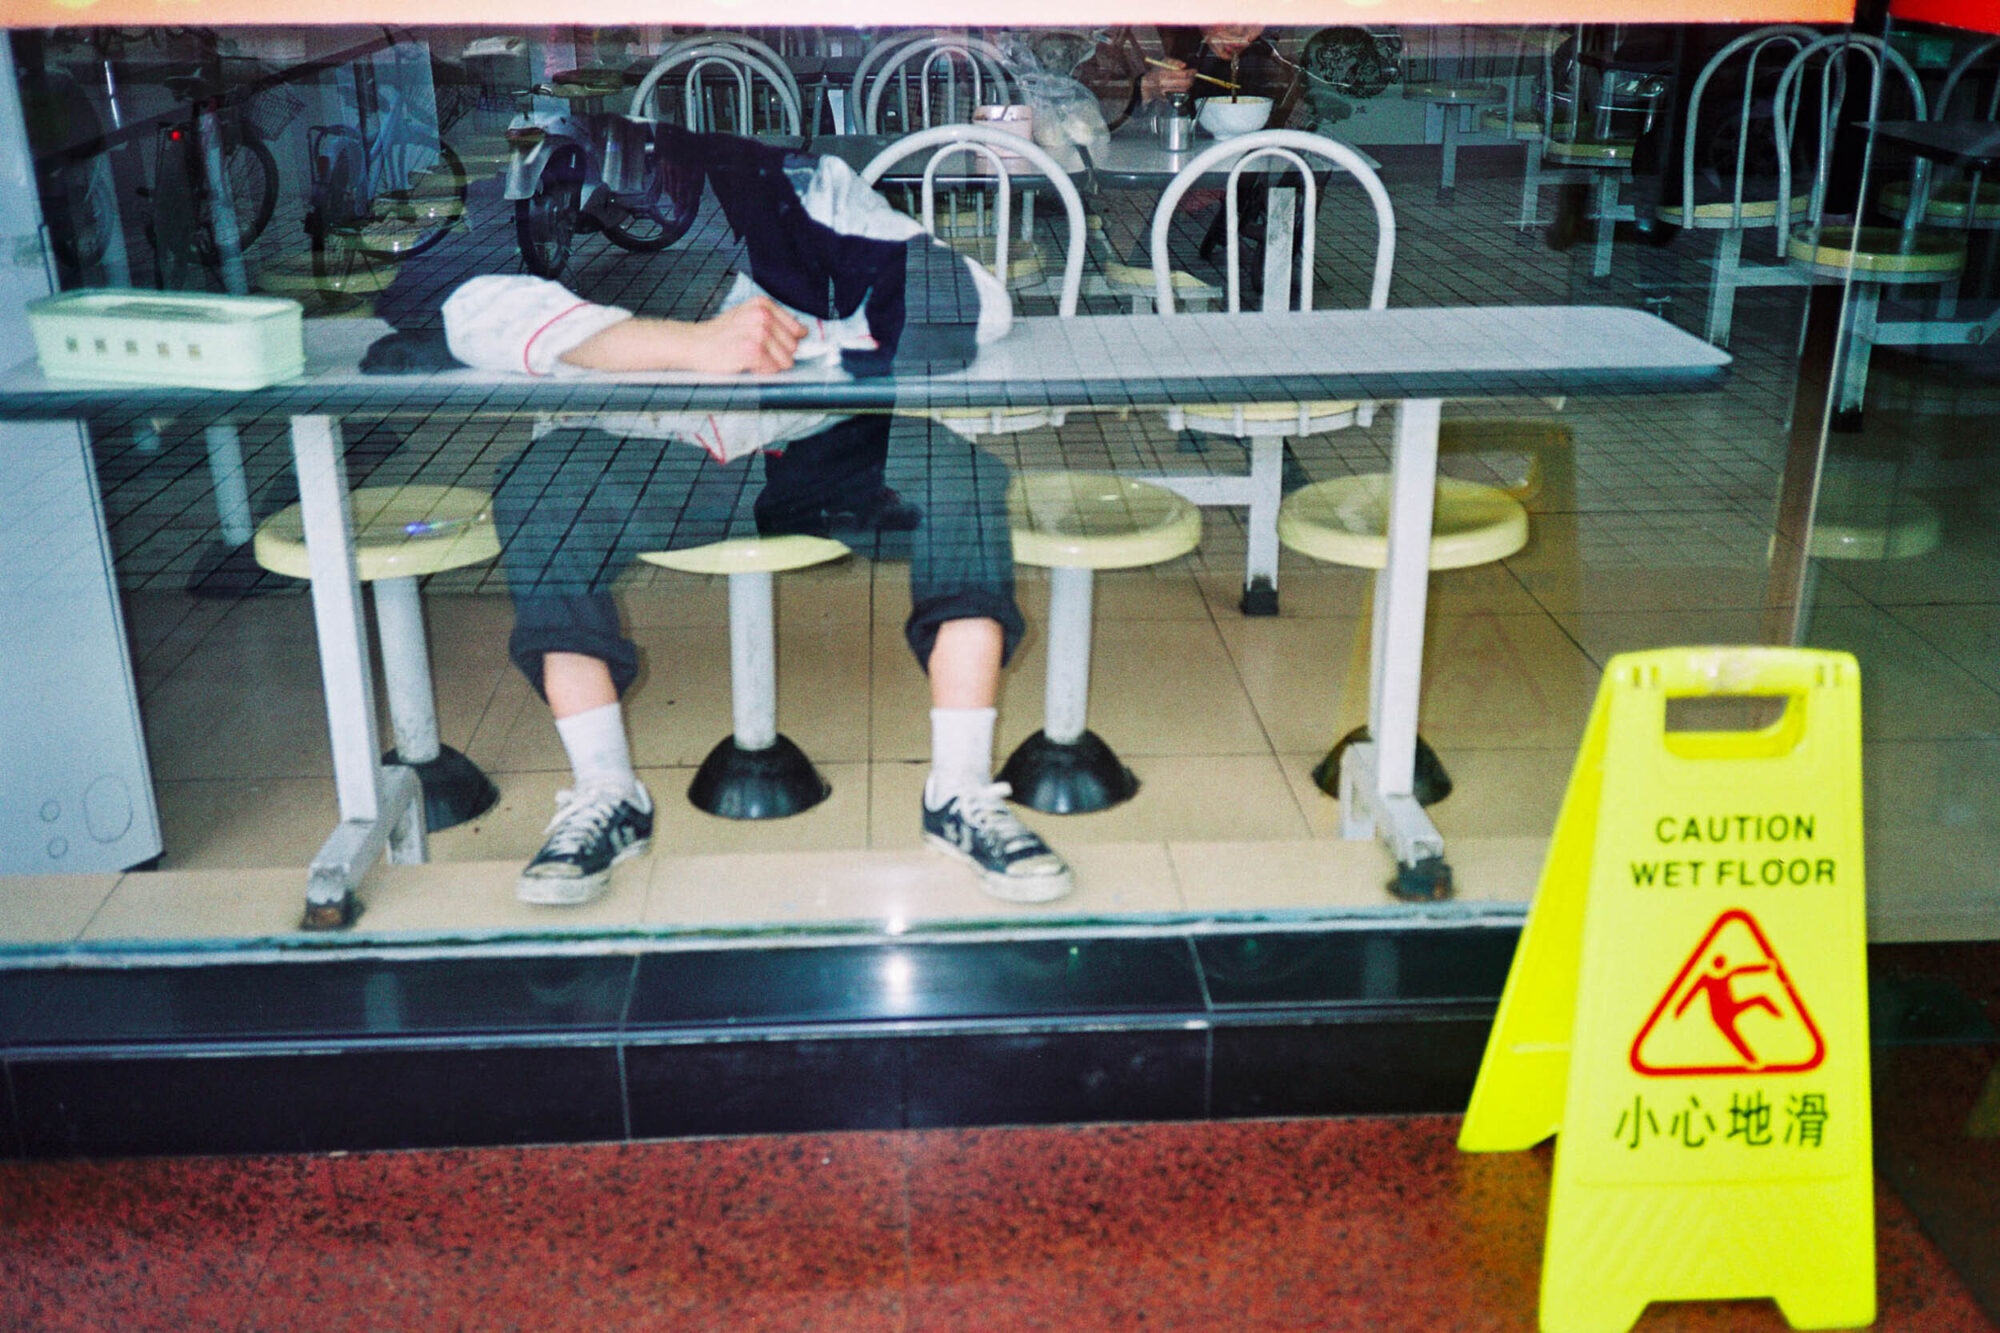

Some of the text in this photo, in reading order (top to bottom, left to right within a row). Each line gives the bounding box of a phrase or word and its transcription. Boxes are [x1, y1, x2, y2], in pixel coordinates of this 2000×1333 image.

[1656, 816, 1814, 843] CAUTION
[1632, 859, 1835, 886] WET FLOOR
[1614, 1091, 1829, 1149] 小心地滑
